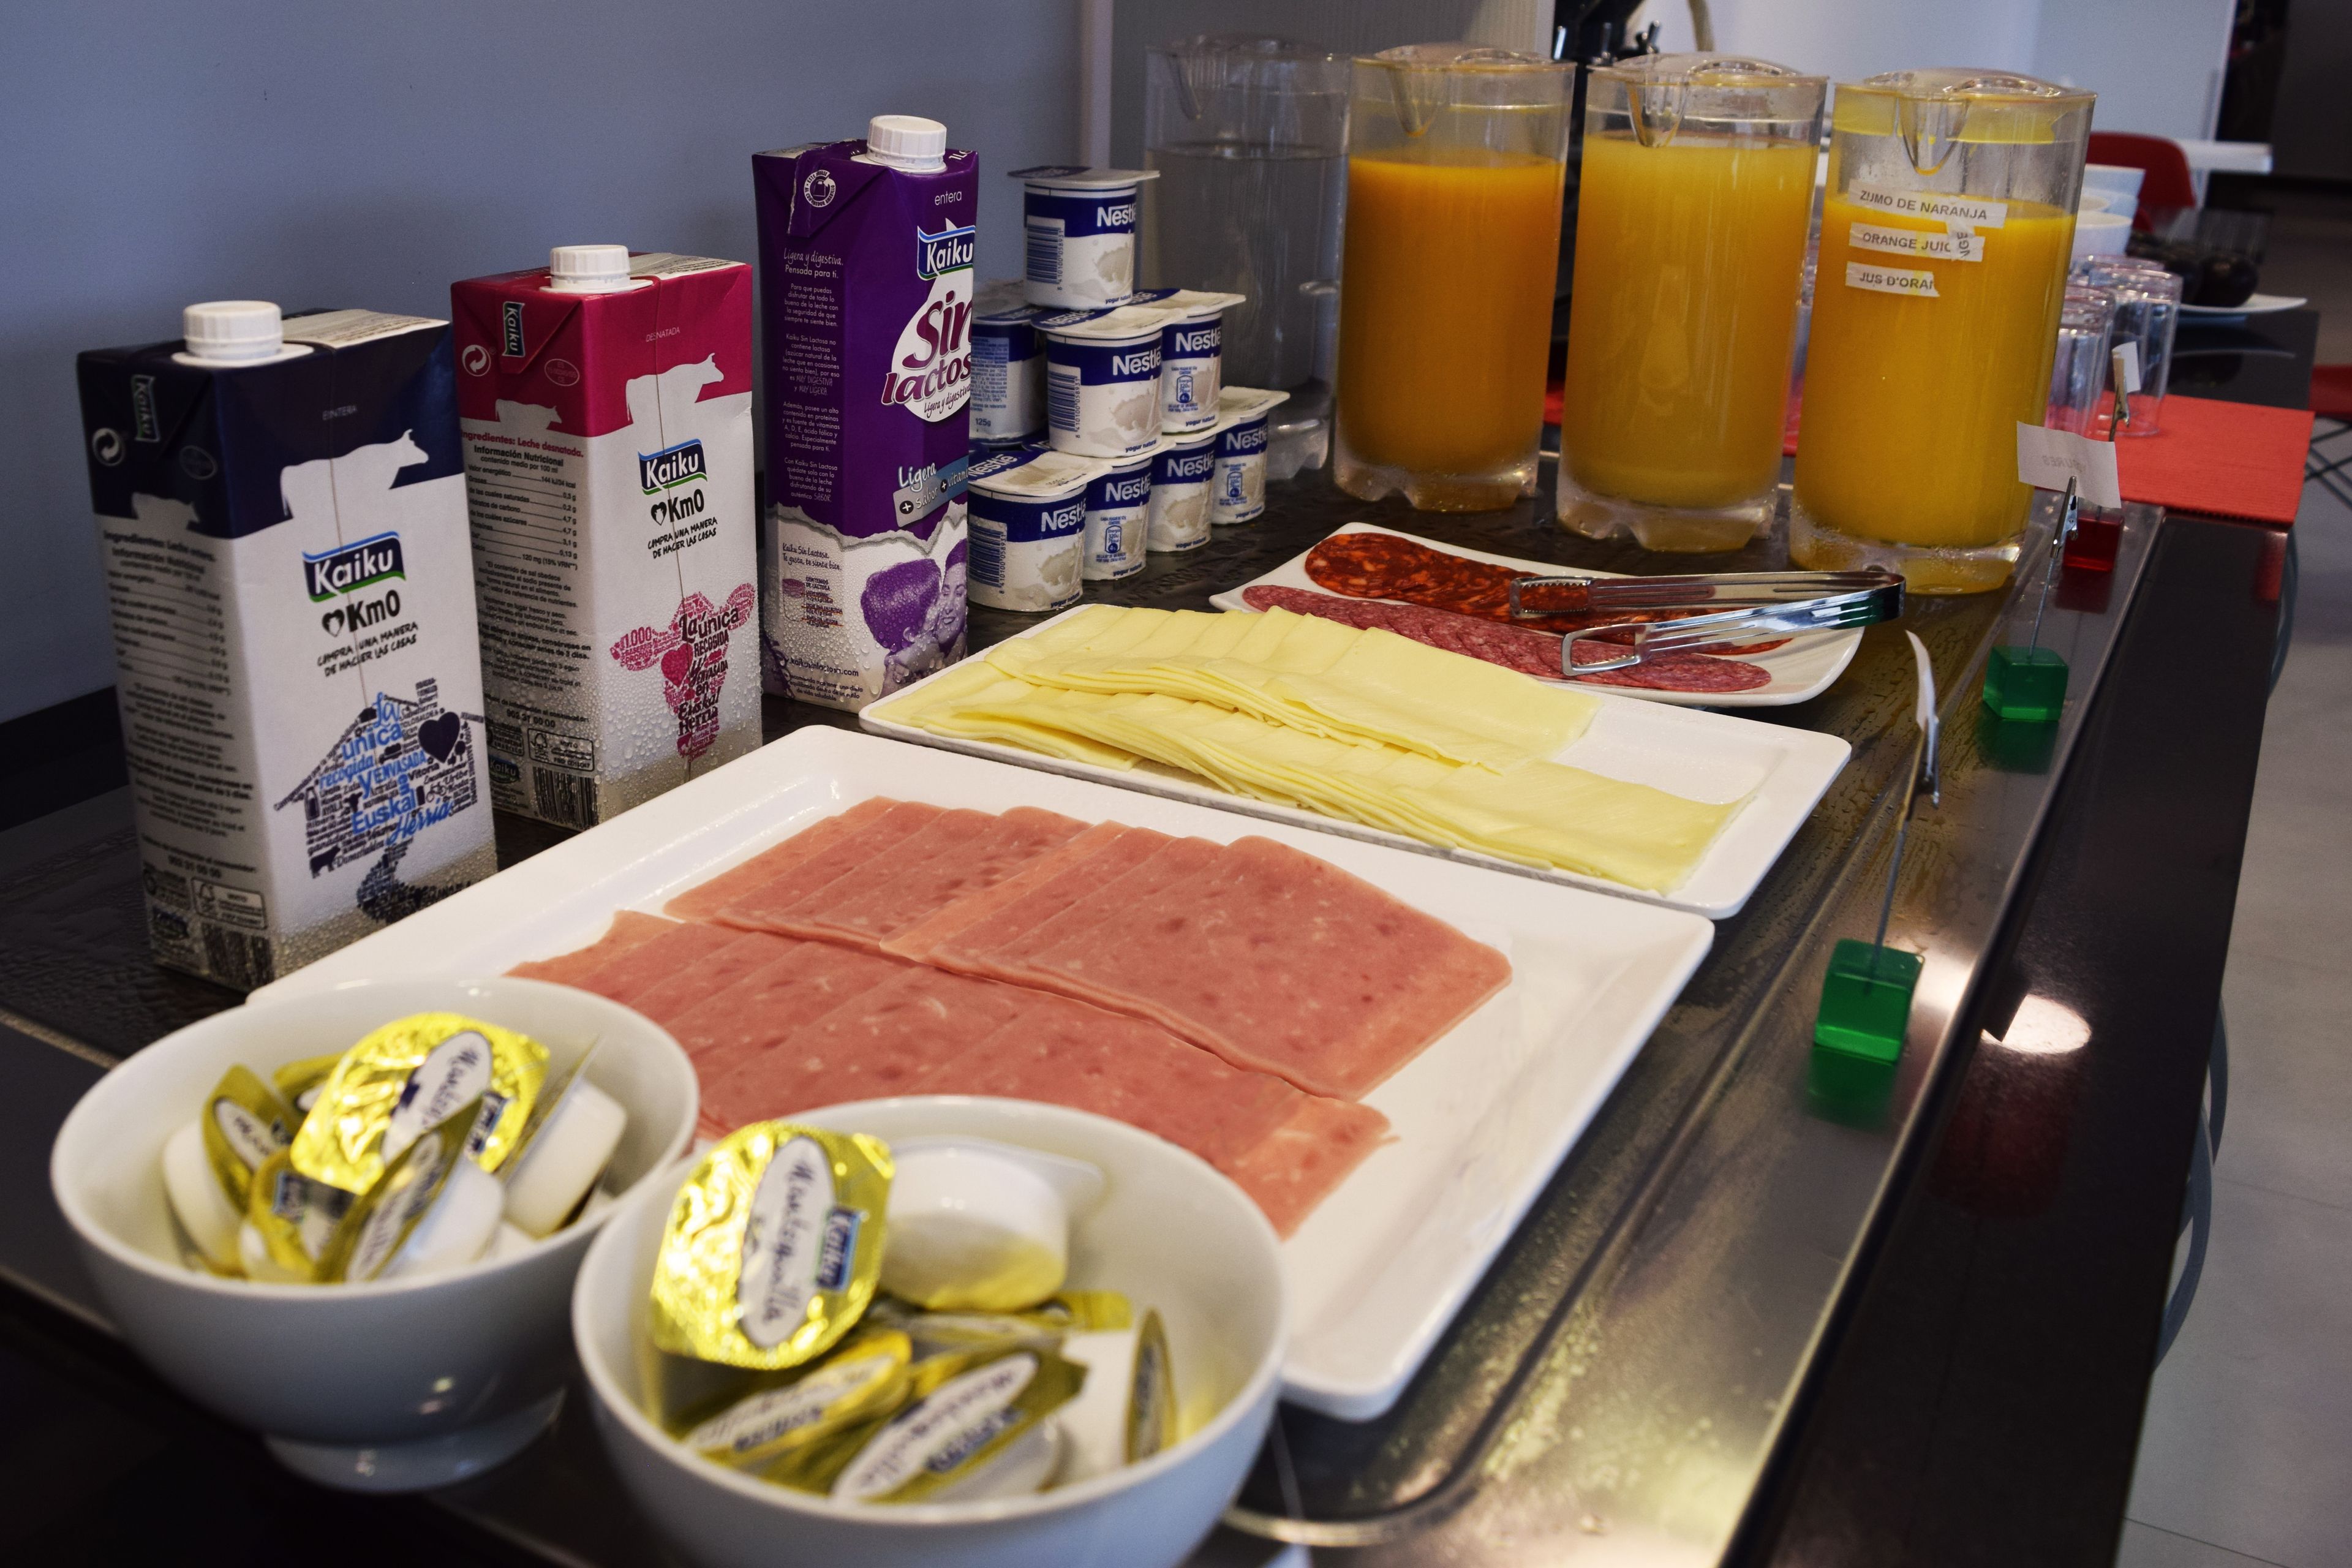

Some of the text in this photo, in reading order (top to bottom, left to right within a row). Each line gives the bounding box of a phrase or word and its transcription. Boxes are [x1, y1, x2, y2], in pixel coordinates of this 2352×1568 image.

[935, 190, 962, 205] entera
[1897, 198, 1916, 210] DE
[1920, 202, 1987, 220] NARANJA
[1863, 233, 1917, 248] ORANGE
[784, 247, 843, 268] Ligera y digestiva.
[927, 238, 973, 273] Kaiku
[785, 264, 812, 275] Pensada
[1860, 273, 1882, 285] JUS
[1106, 296, 1119, 304] yogur
[505, 307, 519, 351] Kaiku
[646, 327, 680, 342] DESNATADA
[902, 290, 972, 369] Sin
[1175, 326, 1221, 352] Nestlé
[1112, 345, 1161, 376] Nestlé
[136, 382, 152, 435] Kaiku
[924, 401, 940, 418] Ligera
[474, 445, 564, 467] Información Nutricional
[518, 437, 540, 449] Leche
[542, 442, 584, 458] desnatada.
[1143, 439, 1156, 448] natural
[481, 456, 509, 465] contenido
[646, 451, 698, 488] Kaiku
[1167, 450, 1215, 477] Nestlé
[790, 482, 816, 491] disfrutando
[898, 462, 937, 492] Ligera
[668, 489, 704, 522] Km0
[916, 487, 938, 509] sabor
[648, 517, 718, 550] COMPRA UNA MANERA
[652, 527, 717, 559] DE HACER LAS COSAS
[782, 543, 797, 553] Kaiku
[808, 548, 829, 559] Lactosa.
[783, 553, 788, 562] Te
[812, 560, 828, 569] sienta
[829, 560, 842, 570] bien.
[314, 548, 393, 595] Kaiku
[346, 589, 401, 632] Km0
[1050, 599, 1067, 608] yogur
[679, 608, 739, 643] La única
[317, 622, 418, 666] COMPRA UNA MANERA
[324, 634, 417, 677] DE HACER LAS COSAS
[694, 629, 729, 657] RECOGIDA
[696, 660, 728, 684] ENVASADA
[696, 682, 709, 696] en
[342, 722, 402, 760] única
[319, 755, 374, 790] recogida
[374, 750, 427, 783] ENVASADA
[491, 760, 516, 776] Kaiku
[352, 789, 416, 834] Euskal
